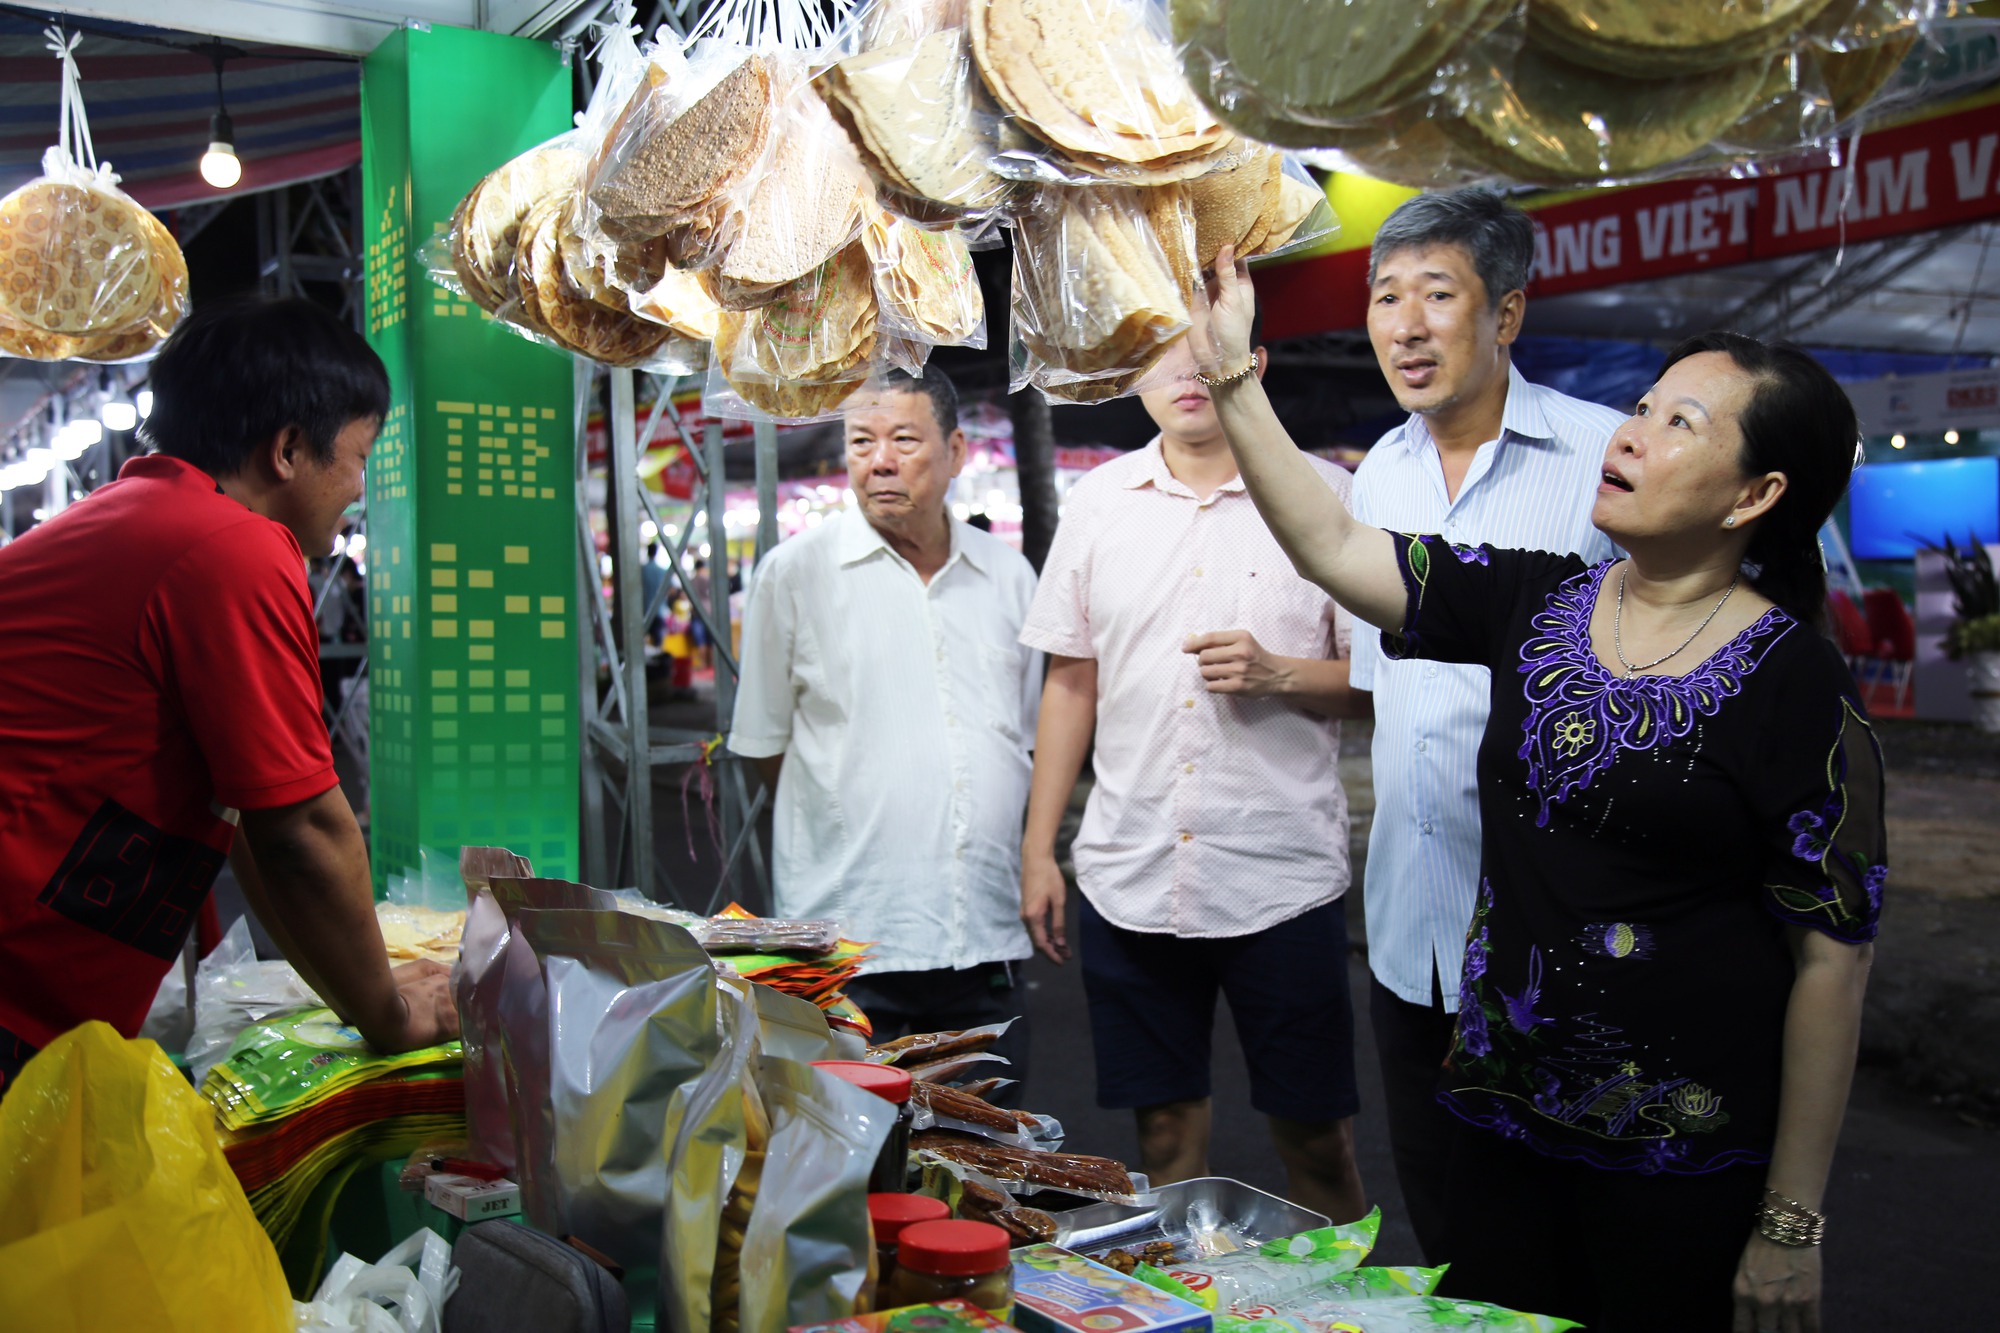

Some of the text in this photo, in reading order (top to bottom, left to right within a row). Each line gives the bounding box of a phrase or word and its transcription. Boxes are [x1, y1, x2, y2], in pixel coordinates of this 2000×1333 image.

[1528, 132, 2000, 282] ÀNG VIỆT NAM V
[436, 400, 556, 499] TRE
[481, 1197, 510, 1214] JET
